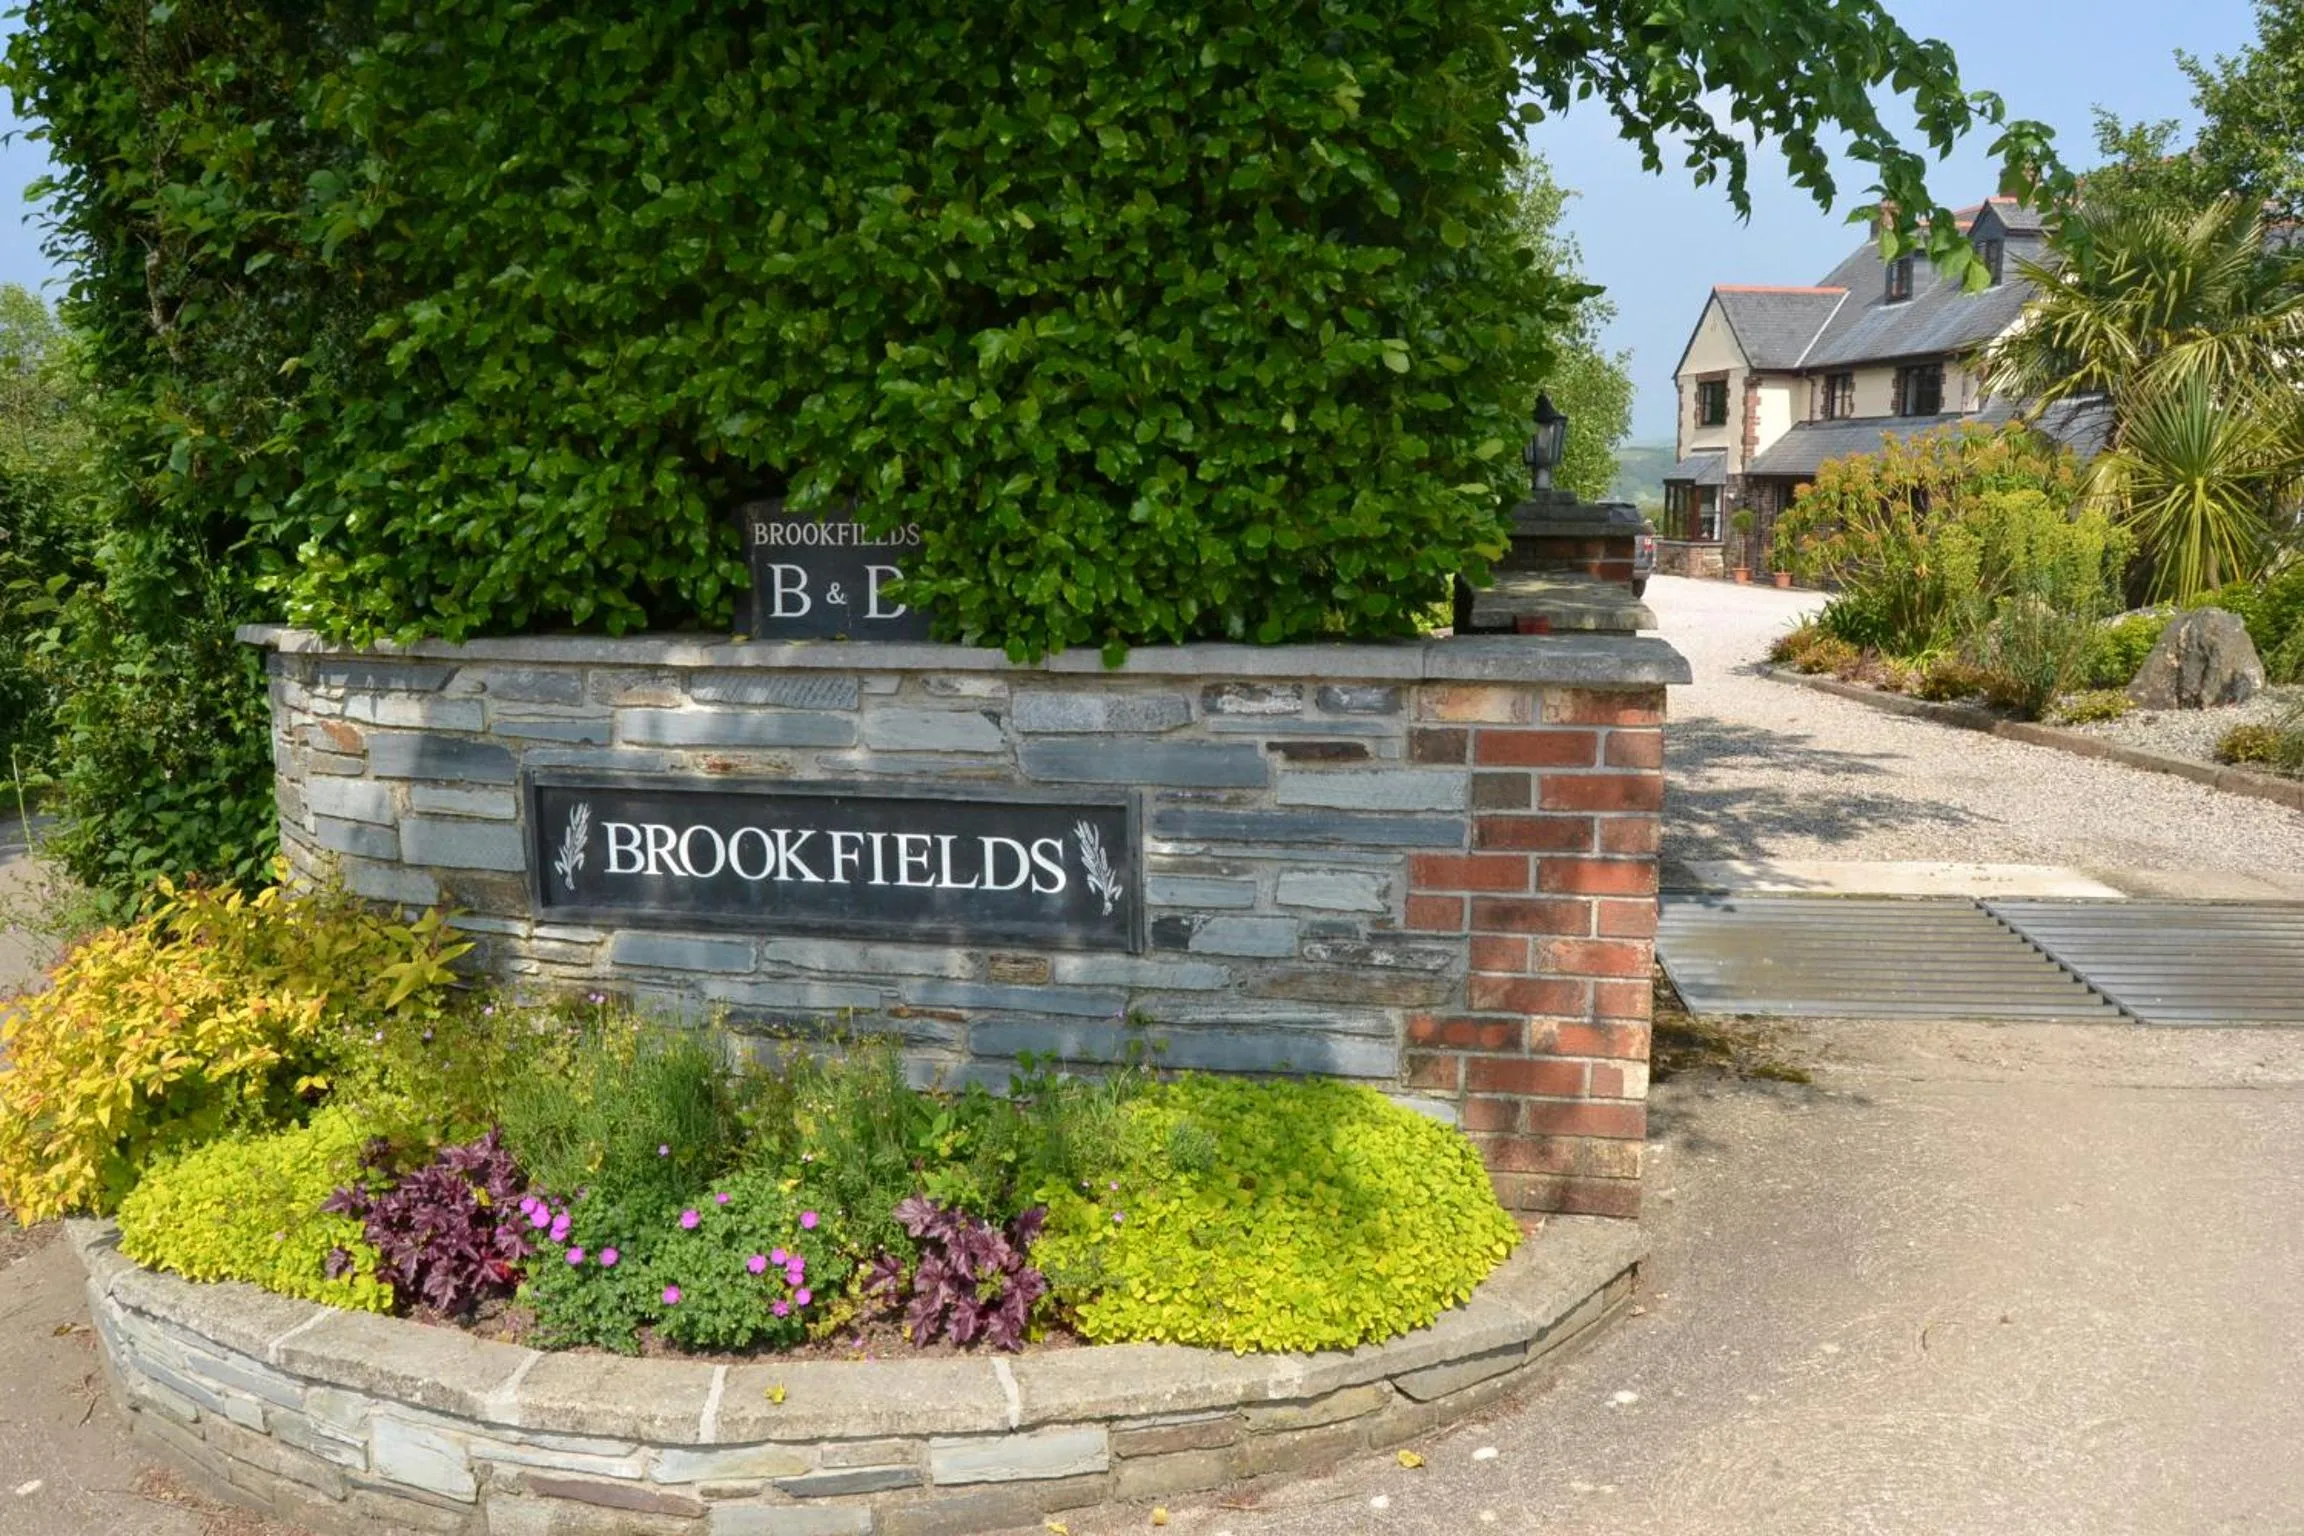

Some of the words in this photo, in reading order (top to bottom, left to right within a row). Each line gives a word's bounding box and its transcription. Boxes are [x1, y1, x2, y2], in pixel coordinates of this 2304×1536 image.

[767, 563, 812, 618] B
[826, 581, 848, 605] &
[602, 821, 1067, 893] BROOKFIELDS
